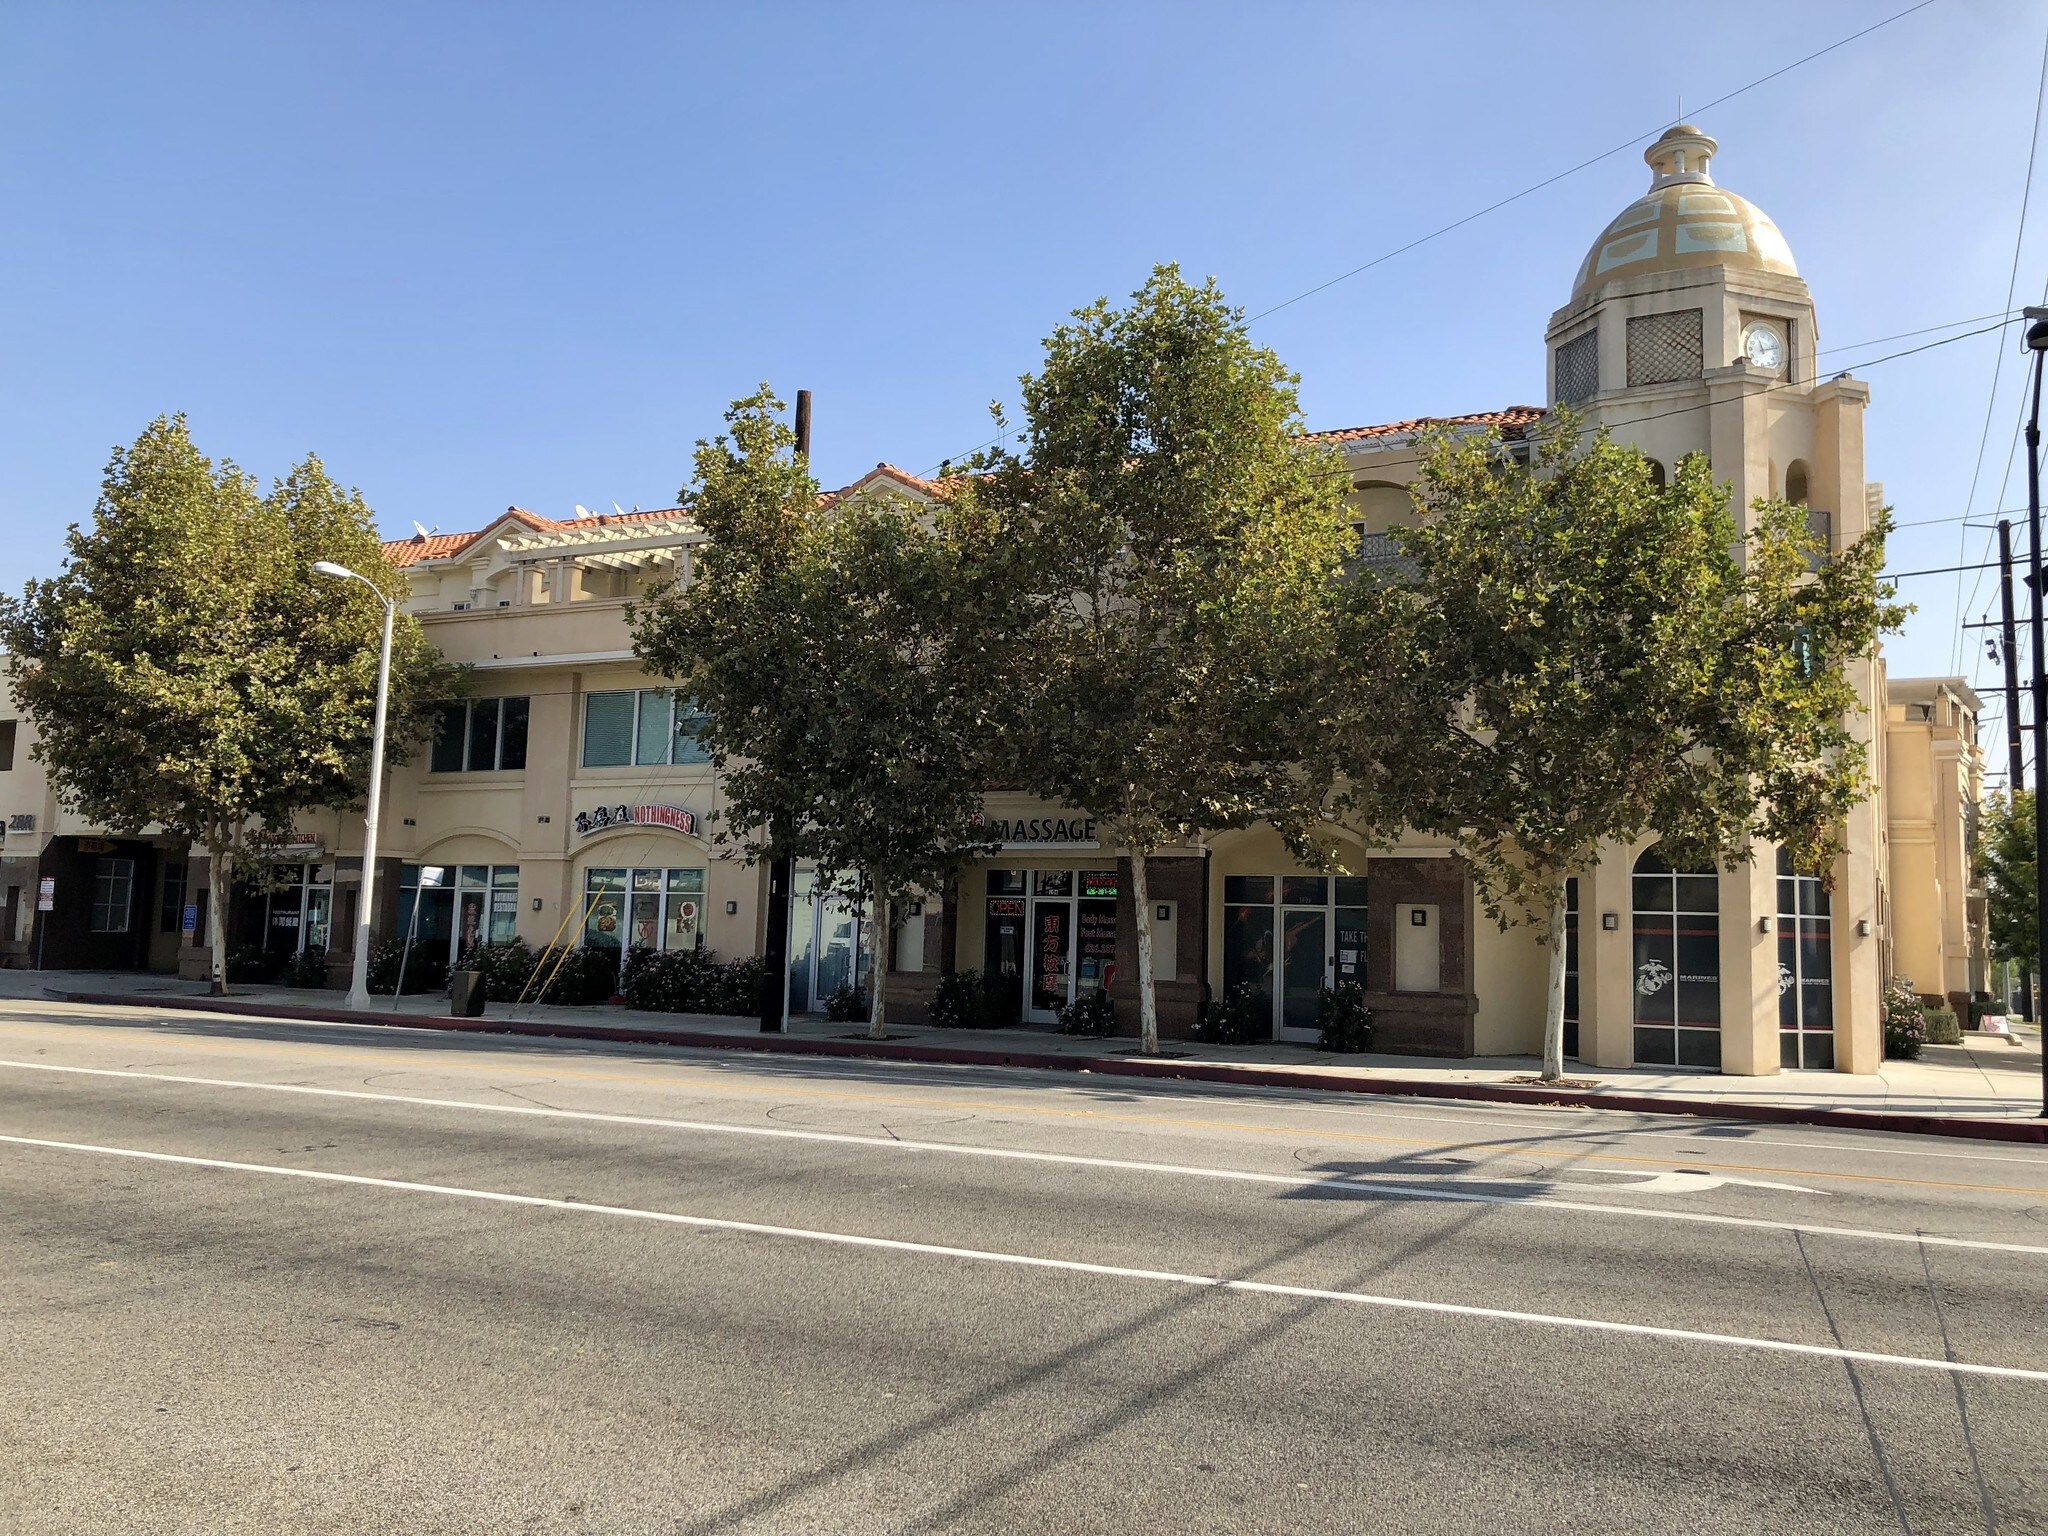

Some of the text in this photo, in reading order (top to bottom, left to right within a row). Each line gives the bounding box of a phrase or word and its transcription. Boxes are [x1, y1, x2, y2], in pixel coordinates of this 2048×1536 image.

[9, 814, 33, 829] 288
[635, 804, 692, 834] NOTHINGNESS
[991, 818, 1096, 840] MASSAGE
[991, 902, 1023, 914] OPEN
[1081, 913, 1097, 926] Body
[1080, 927, 1096, 938] Foot
[1340, 930, 1358, 943] TAKE
